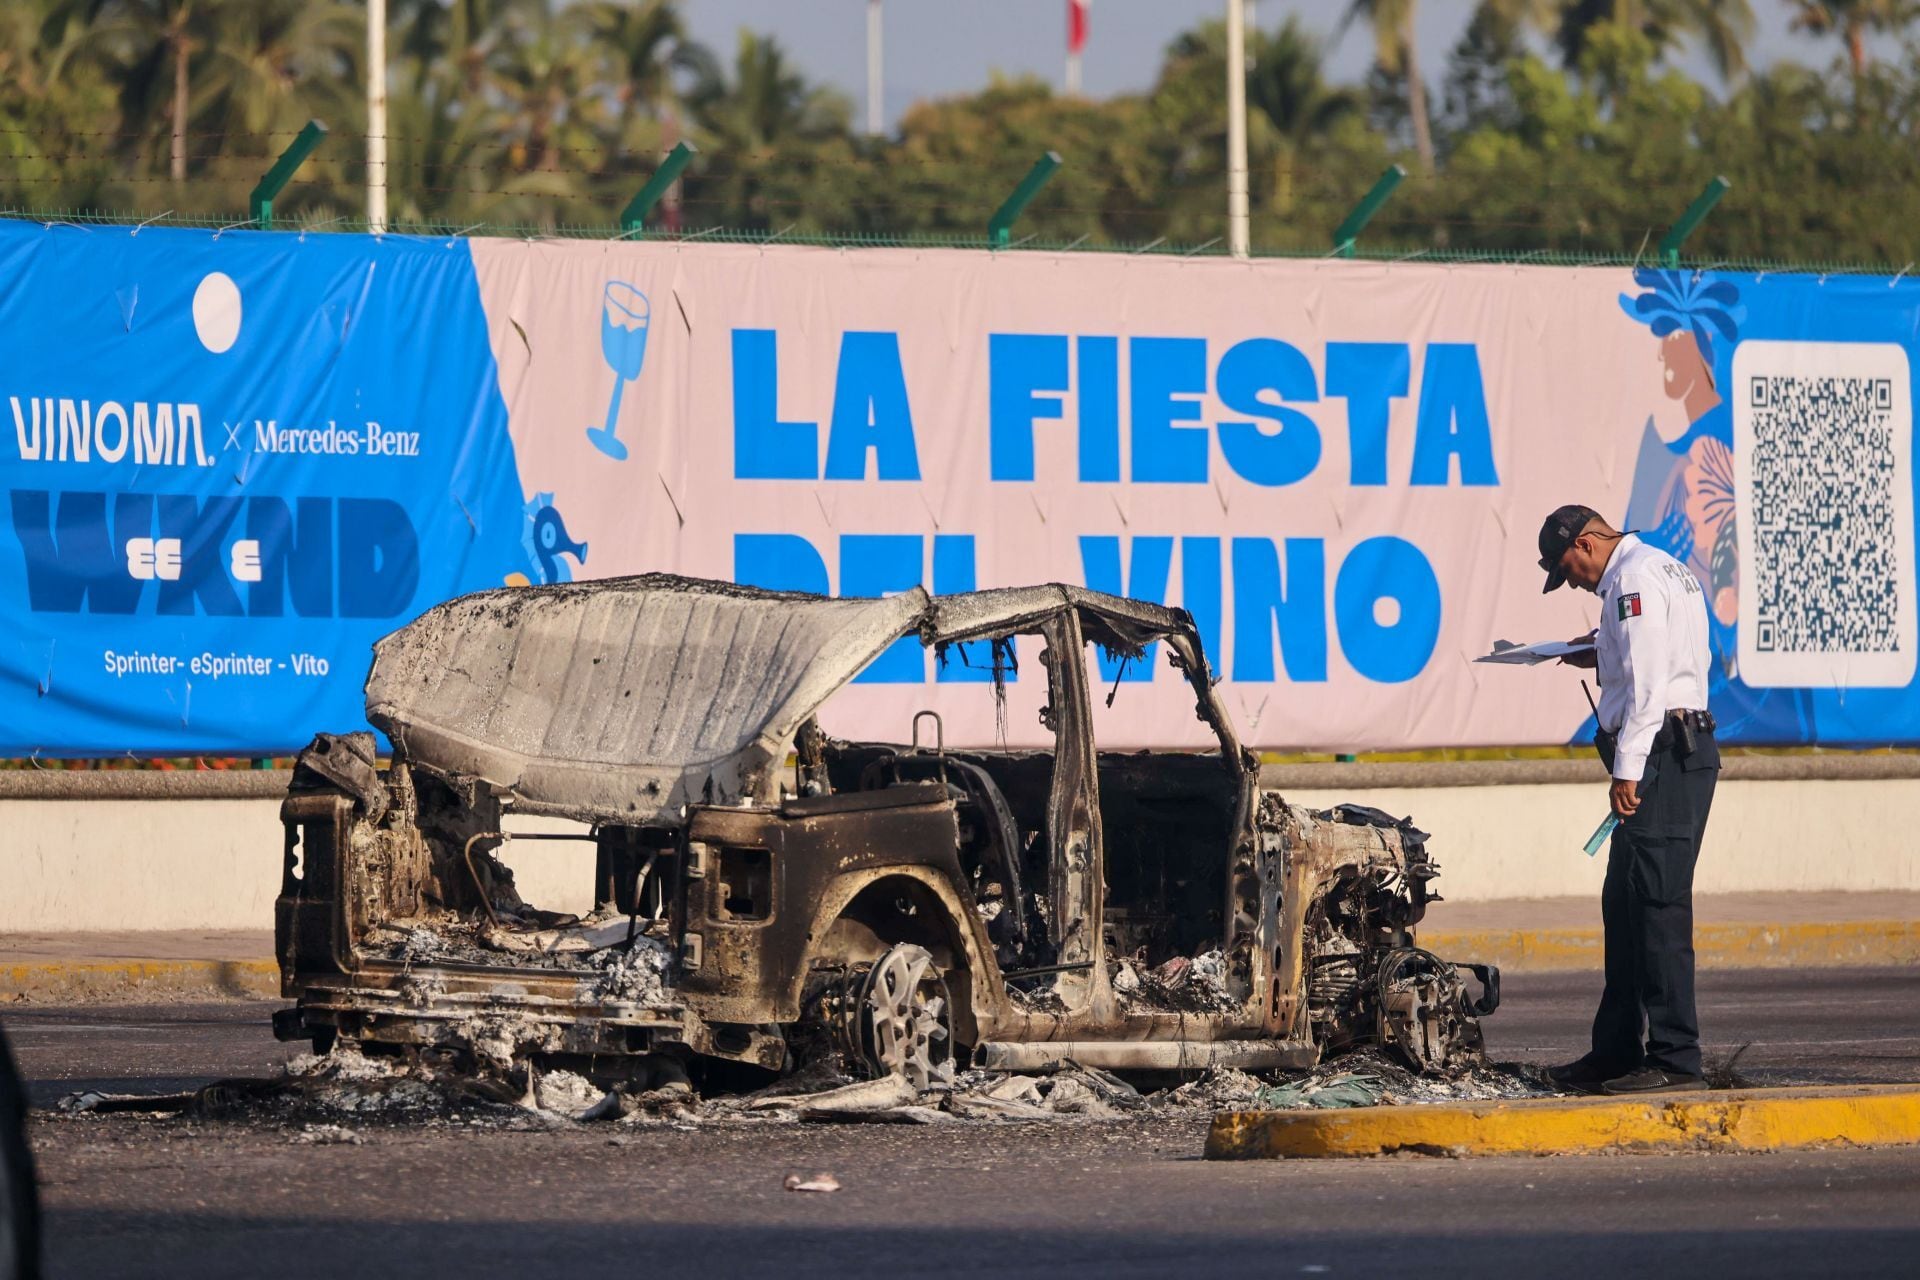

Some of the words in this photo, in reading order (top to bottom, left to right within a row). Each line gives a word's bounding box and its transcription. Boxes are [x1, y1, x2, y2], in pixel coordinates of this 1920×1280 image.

[254, 420, 420, 456] Mercedes-Benz
[731, 328, 922, 480] LA
[989, 333, 1501, 487] FIESTA
[1078, 535, 1442, 683] VINO
[190, 652, 272, 680] eSprinter
[291, 653, 329, 677] Vito
